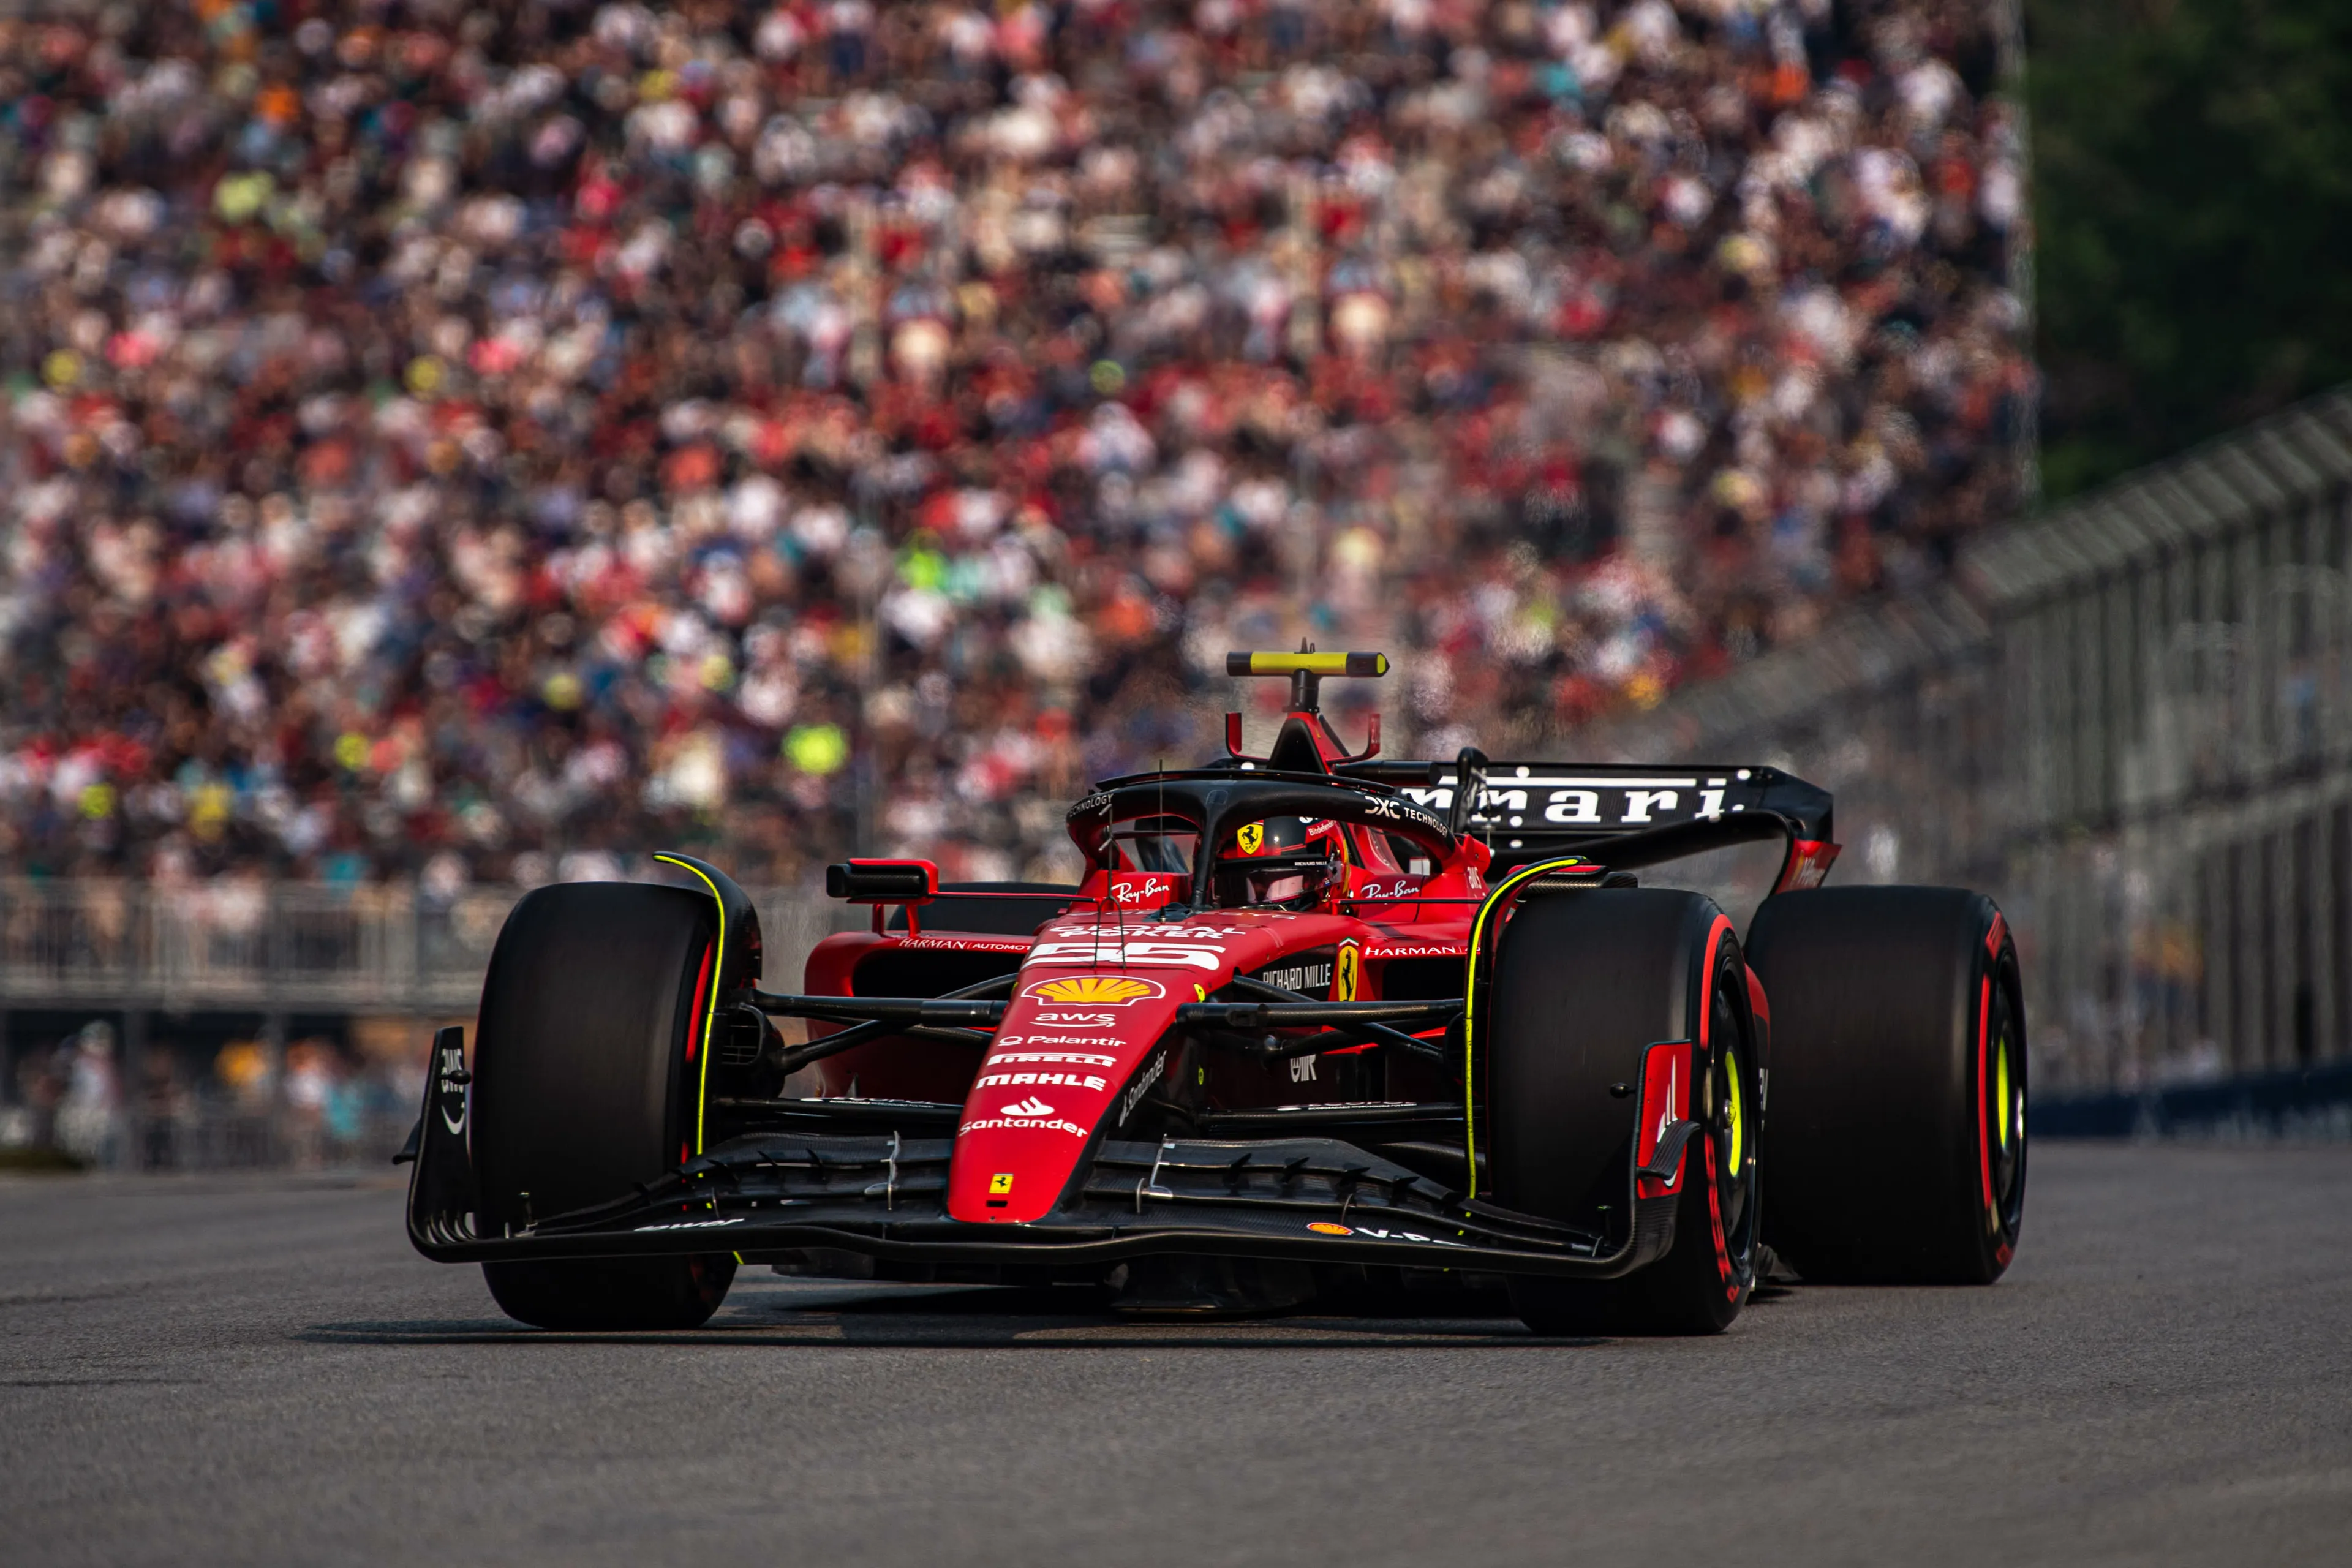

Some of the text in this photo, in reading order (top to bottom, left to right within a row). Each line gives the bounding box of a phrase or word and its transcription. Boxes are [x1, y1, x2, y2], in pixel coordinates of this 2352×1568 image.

[1365, 796, 1448, 837] DXC TECHNOLOGY
[1111, 878, 1170, 903] Ray-Ban
[1361, 880, 1420, 905] Ray-Ban
[1049, 925, 1246, 935] GLOBAL
[1058, 930, 1224, 939] POKER
[899, 938, 968, 949] HARMAN
[1365, 946, 1456, 956] HARMAN
[1019, 942, 1225, 970] 55
[1304, 963, 1331, 988] MILLE
[1033, 1012, 1116, 1023] aws
[1027, 1036, 1127, 1047] Palantir
[987, 1052, 1117, 1068] PIRELLI
[976, 1073, 1106, 1091] MAHLE
[958, 1117, 1088, 1137] Santander
